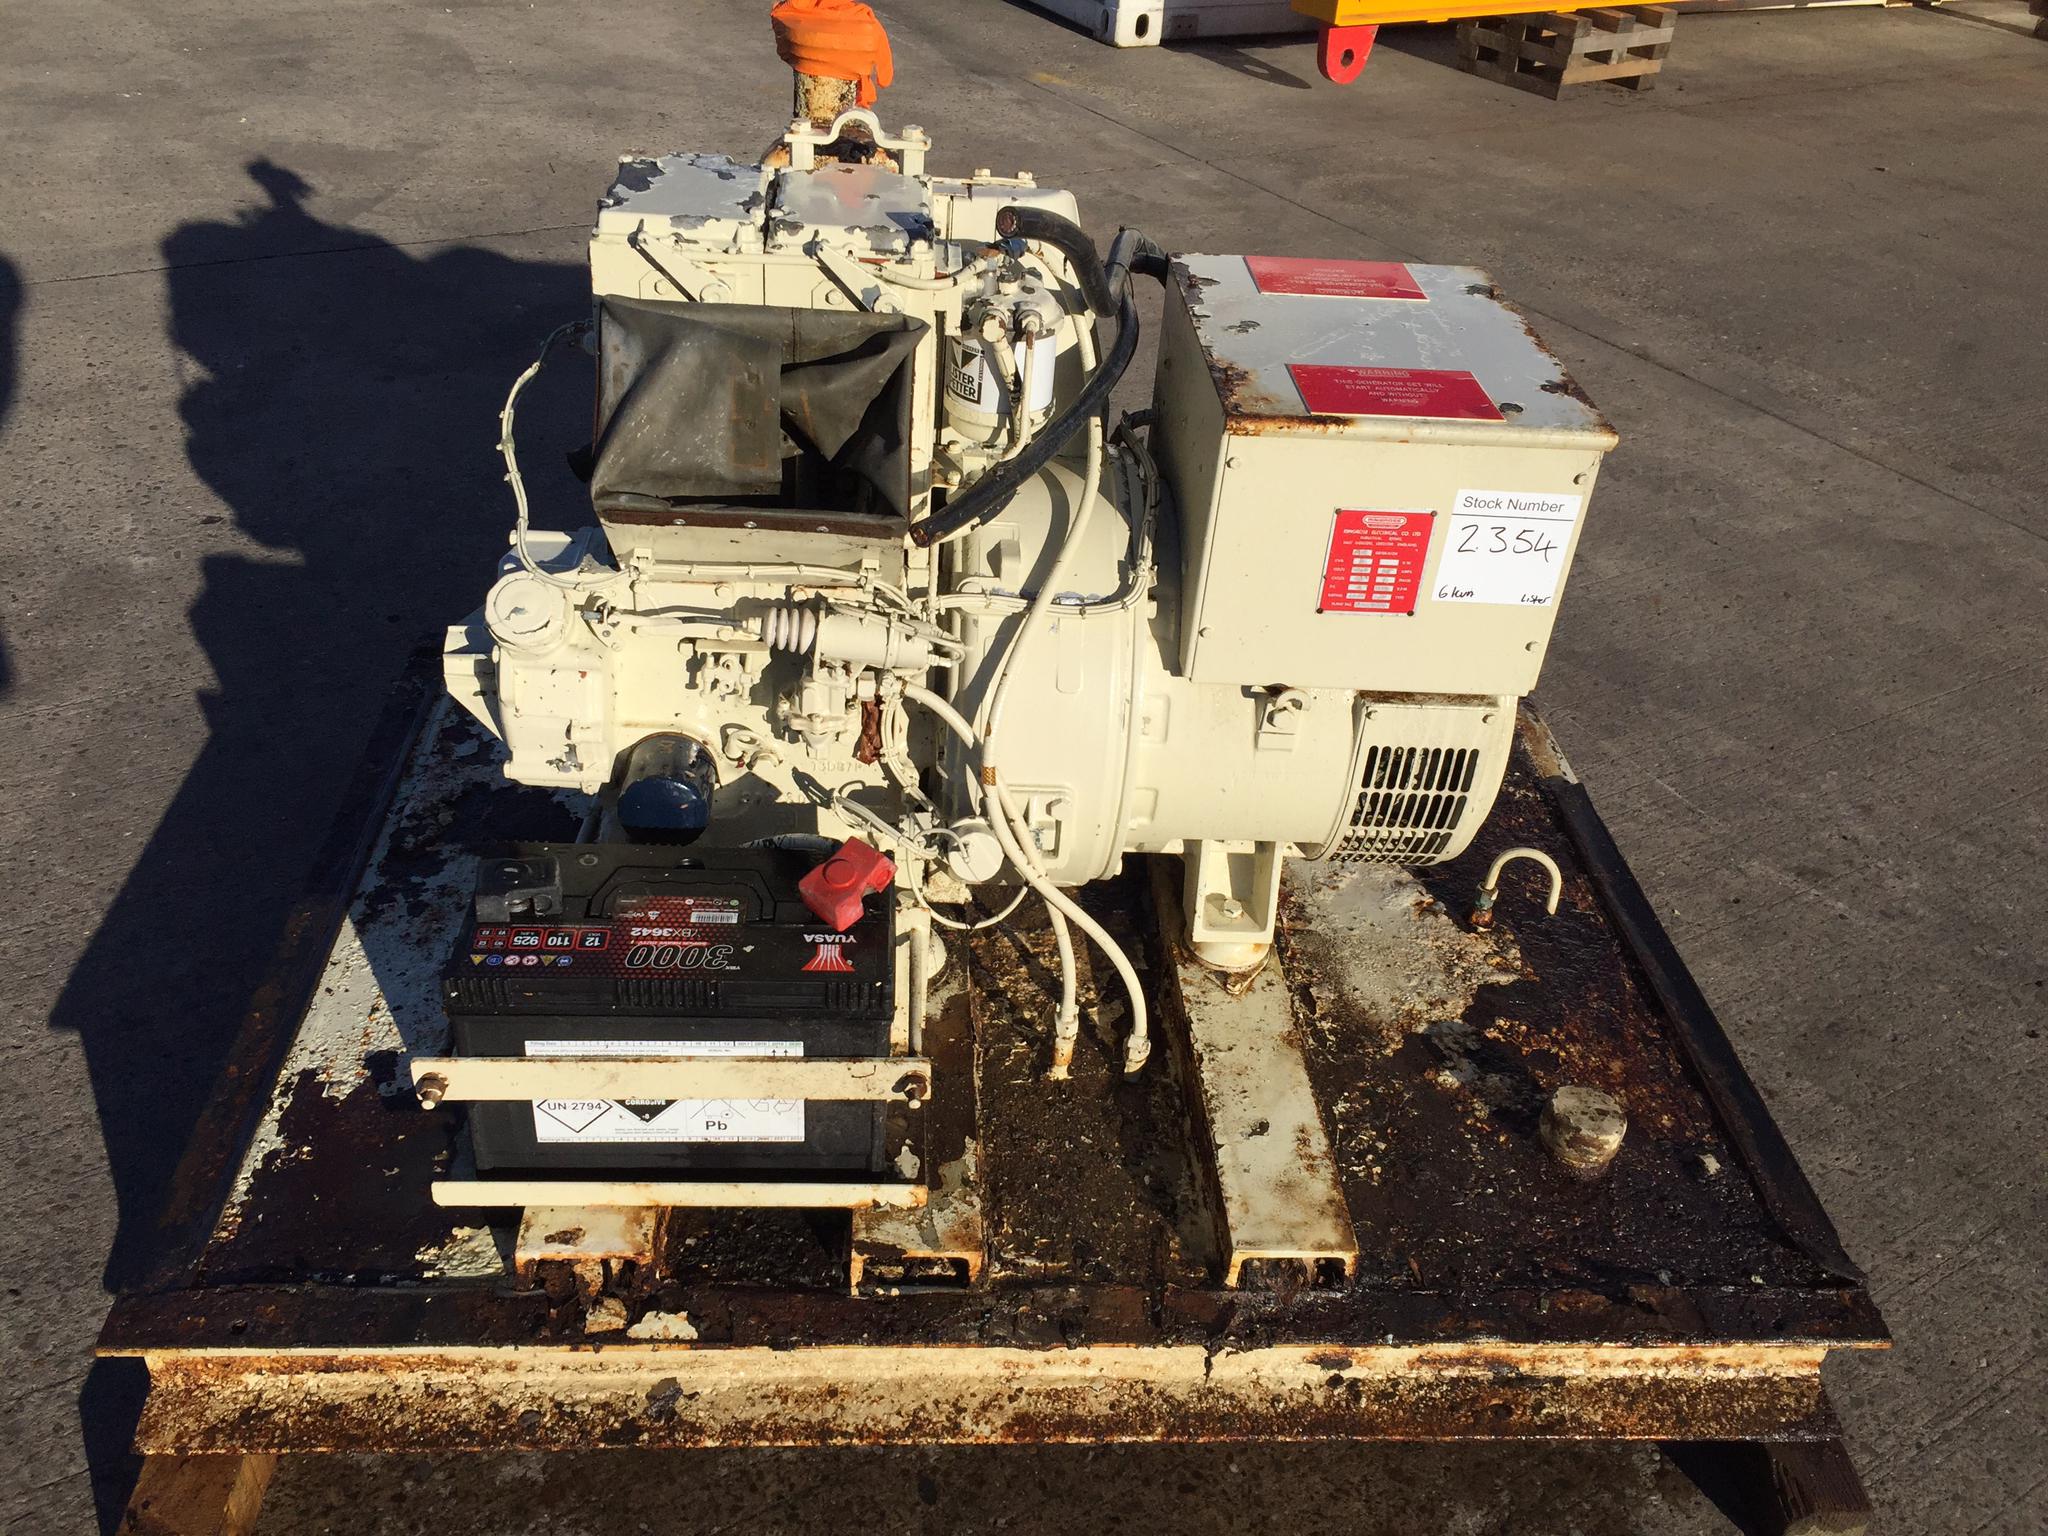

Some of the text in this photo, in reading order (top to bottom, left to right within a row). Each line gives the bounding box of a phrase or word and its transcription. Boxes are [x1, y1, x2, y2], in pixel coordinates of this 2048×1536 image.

[1463, 496, 1565, 513] Stock Number
[1458, 524, 1558, 563] 2354
[1438, 585, 1448, 599] 6
[630, 927, 701, 938] YBX3642
[513, 936, 540, 946] 925
[547, 936, 570, 946] 110
[585, 936, 602, 947] 12
[803, 933, 858, 944] YUASA
[625, 944, 734, 970] 3000
[548, 1102, 602, 1111] UN 2794
[705, 1120, 728, 1130] Pb
